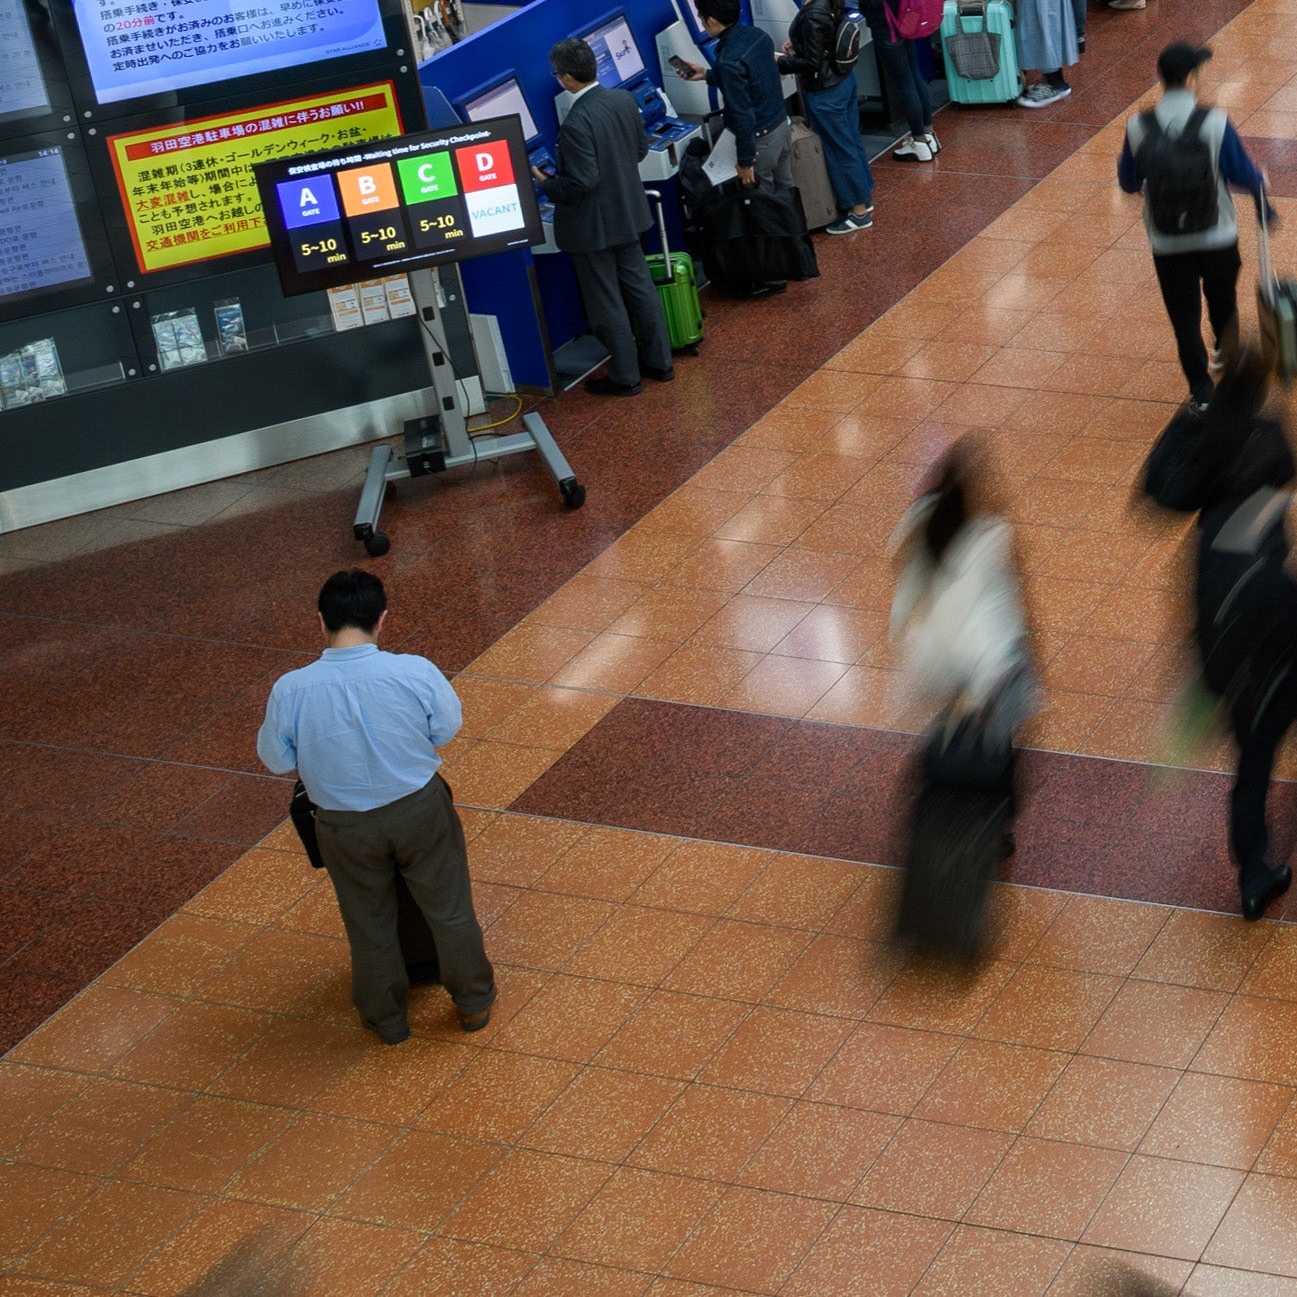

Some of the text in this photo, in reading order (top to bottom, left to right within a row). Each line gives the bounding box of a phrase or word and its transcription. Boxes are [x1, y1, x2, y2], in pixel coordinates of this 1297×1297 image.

[392, 146, 408, 158] time
[408, 144, 420, 155] for
[420, 137, 449, 154] Security
[475, 152, 494, 172] D
[418, 163, 435, 183] C
[479, 172, 497, 182] GATE
[358, 175, 376, 195] B
[421, 184, 439, 194] GATE
[300, 187, 318, 207] A
[362, 196, 380, 205] GATE
[302, 208, 320, 216] GATE
[471, 202, 518, 220] VACANT
[445, 228, 463, 239] min
[387, 240, 405, 252] min
[327, 252, 347, 264] min
